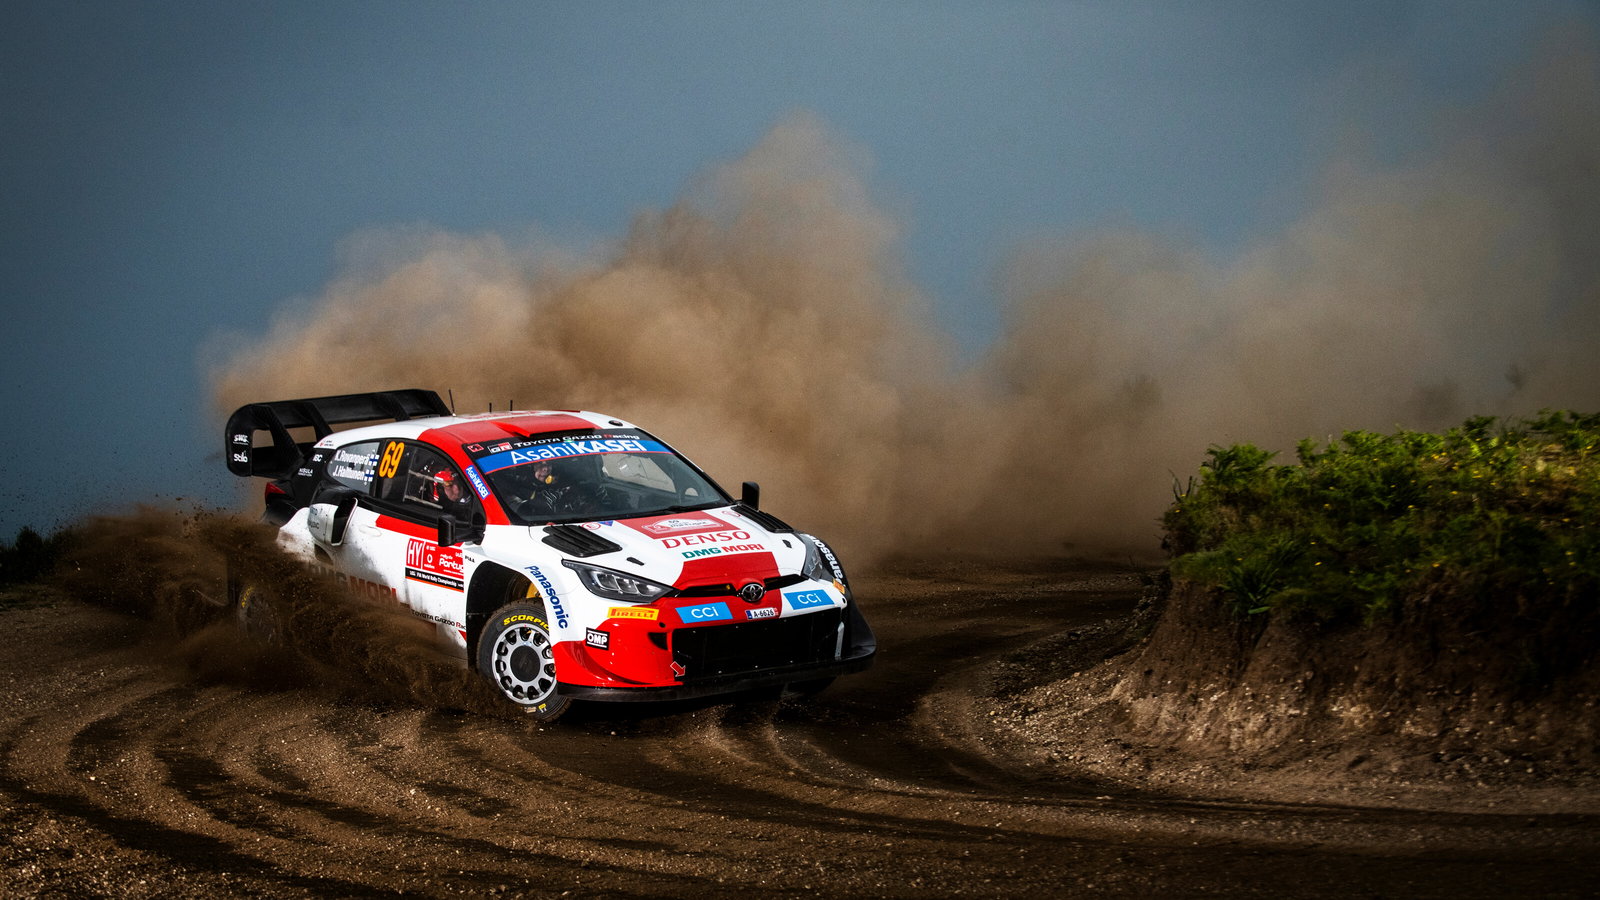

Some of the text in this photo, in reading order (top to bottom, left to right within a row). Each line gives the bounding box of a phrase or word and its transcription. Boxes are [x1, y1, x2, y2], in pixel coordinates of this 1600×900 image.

[514, 437, 560, 448] TOYOTA
[562, 434, 602, 442] GAZOO
[379, 440, 405, 479] 69
[661, 530, 751, 549] DENSO
[681, 543, 765, 559] DMG MORI
[524, 565, 569, 630] Panasonic
[410, 608, 434, 621] TOYOTA
[610, 608, 655, 618] PIRELLI
[586, 632, 608, 645] OMP
